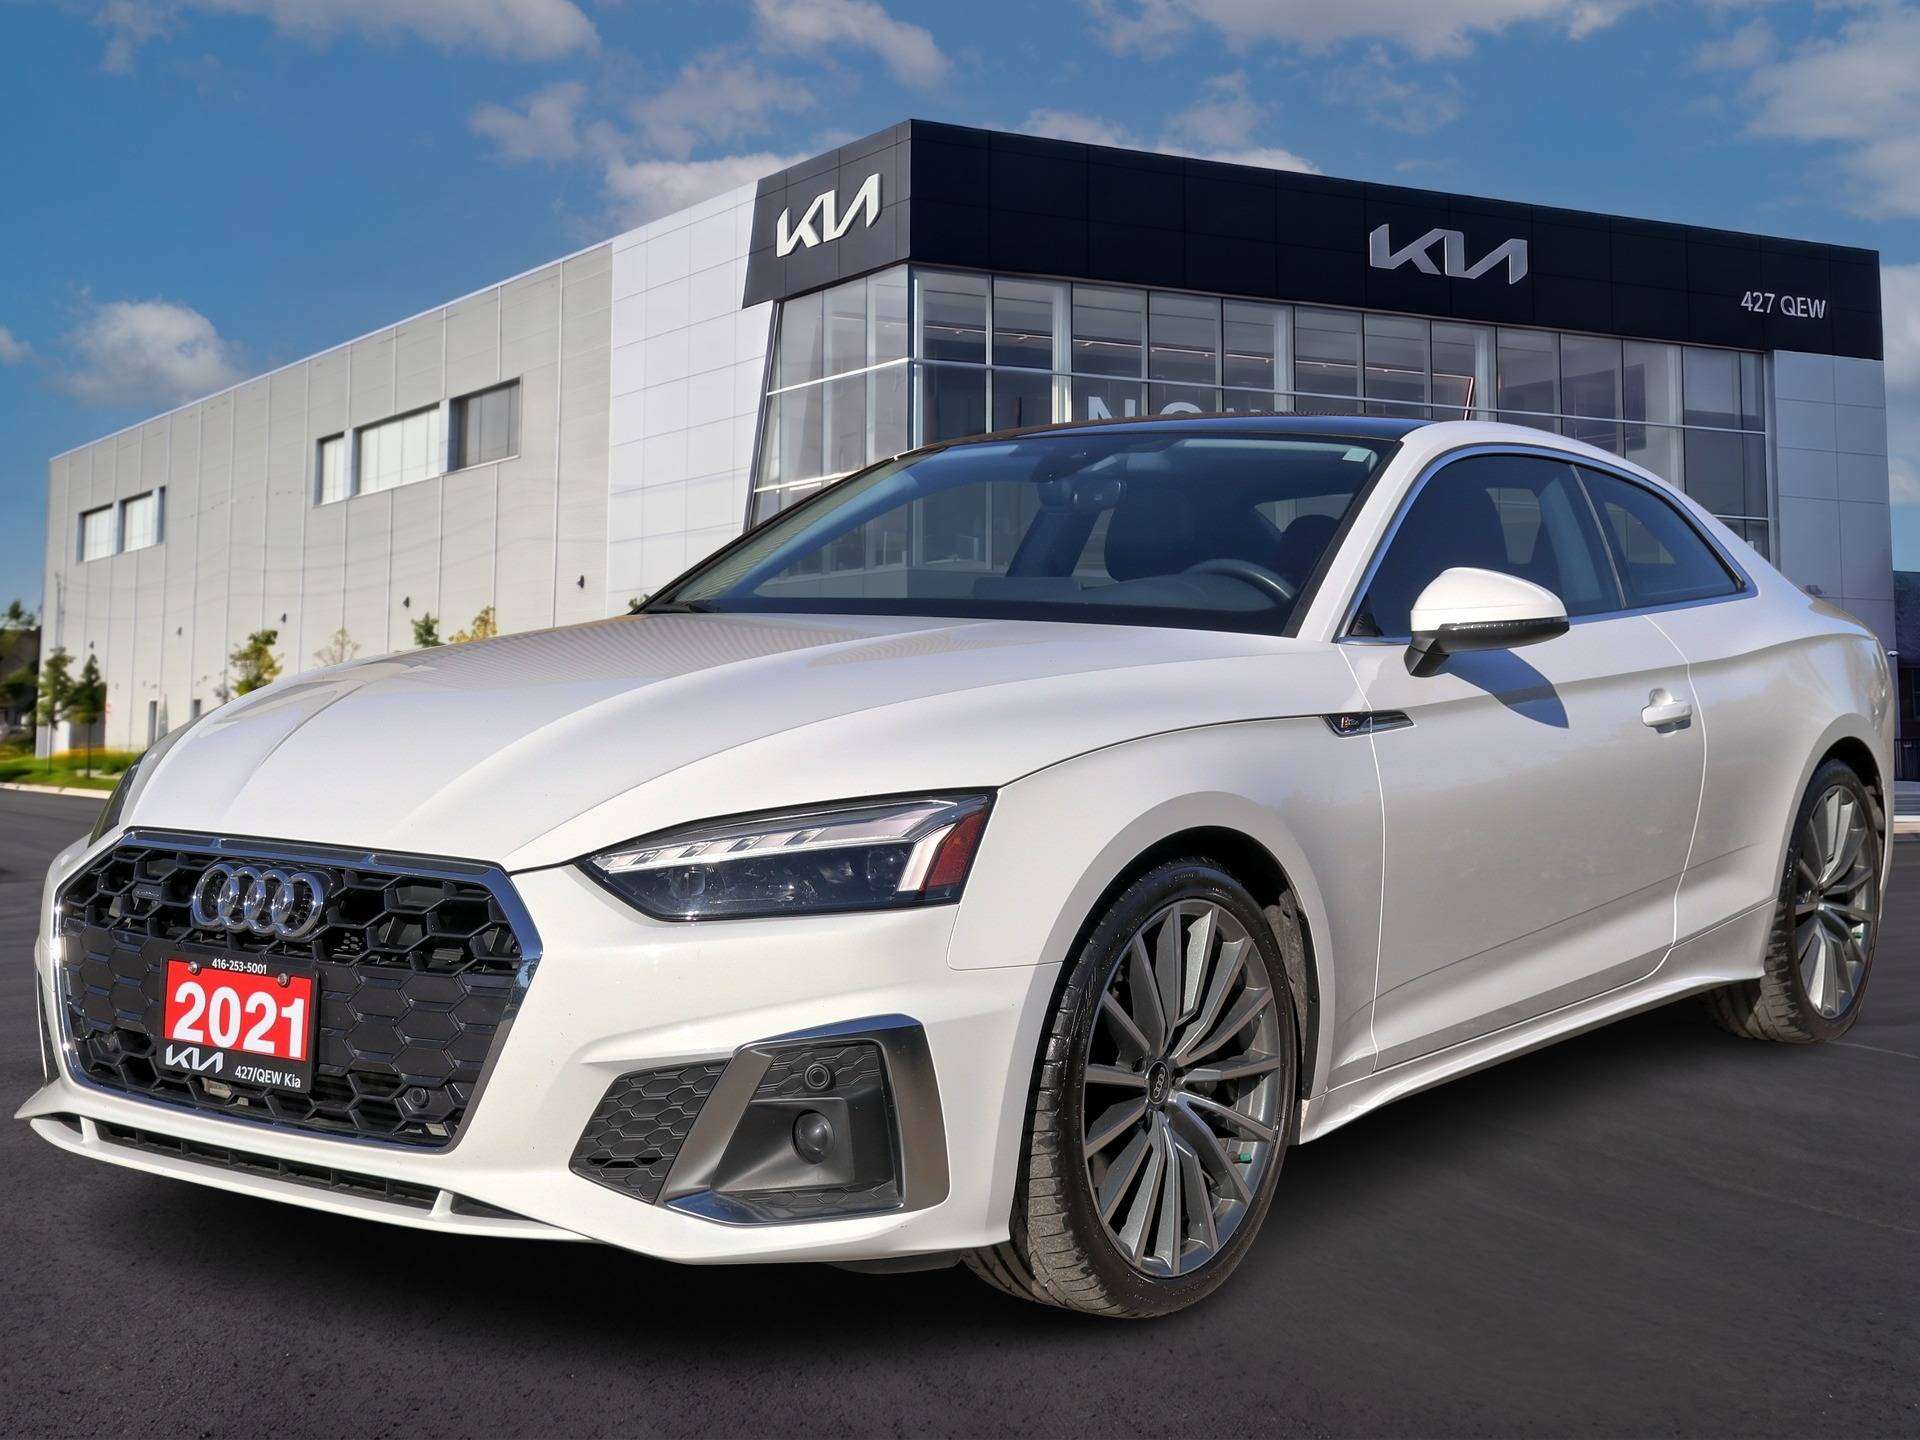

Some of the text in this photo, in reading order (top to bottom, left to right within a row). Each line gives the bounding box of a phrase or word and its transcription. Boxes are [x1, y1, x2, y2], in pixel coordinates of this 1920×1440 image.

[776, 173, 881, 258] KIA
[1369, 224, 1529, 285] KIA
[1740, 291, 1826, 318] 427 QEW
[211, 958, 267, 975] 416-253-5001
[172, 981, 304, 1059] 2021
[234, 1065, 301, 1088] 427/QEW Kia
